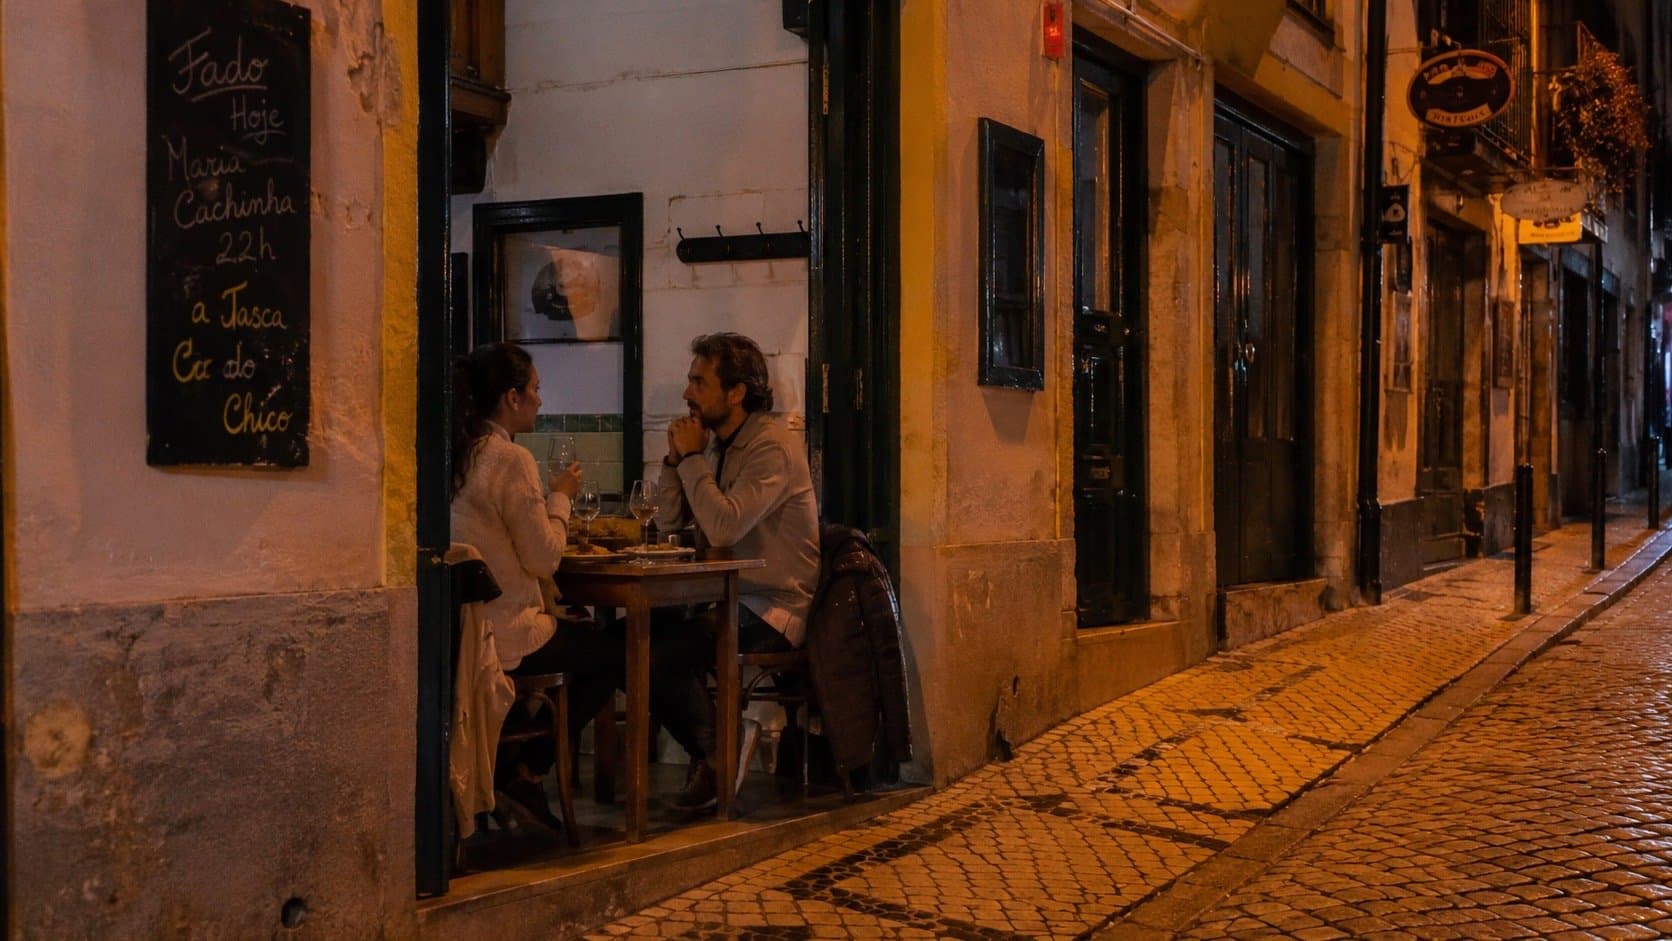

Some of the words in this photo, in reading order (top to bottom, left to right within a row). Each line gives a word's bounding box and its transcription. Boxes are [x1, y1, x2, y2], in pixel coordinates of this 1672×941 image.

[168, 25, 270, 96] Fado
[229, 94, 287, 145] Hoje
[160, 134, 247, 182] Maria
[174, 177, 298, 229] Cachinha
[216, 226, 277, 264] 22h
[191, 300, 211, 324] a
[220, 280, 288, 330] Tasca
